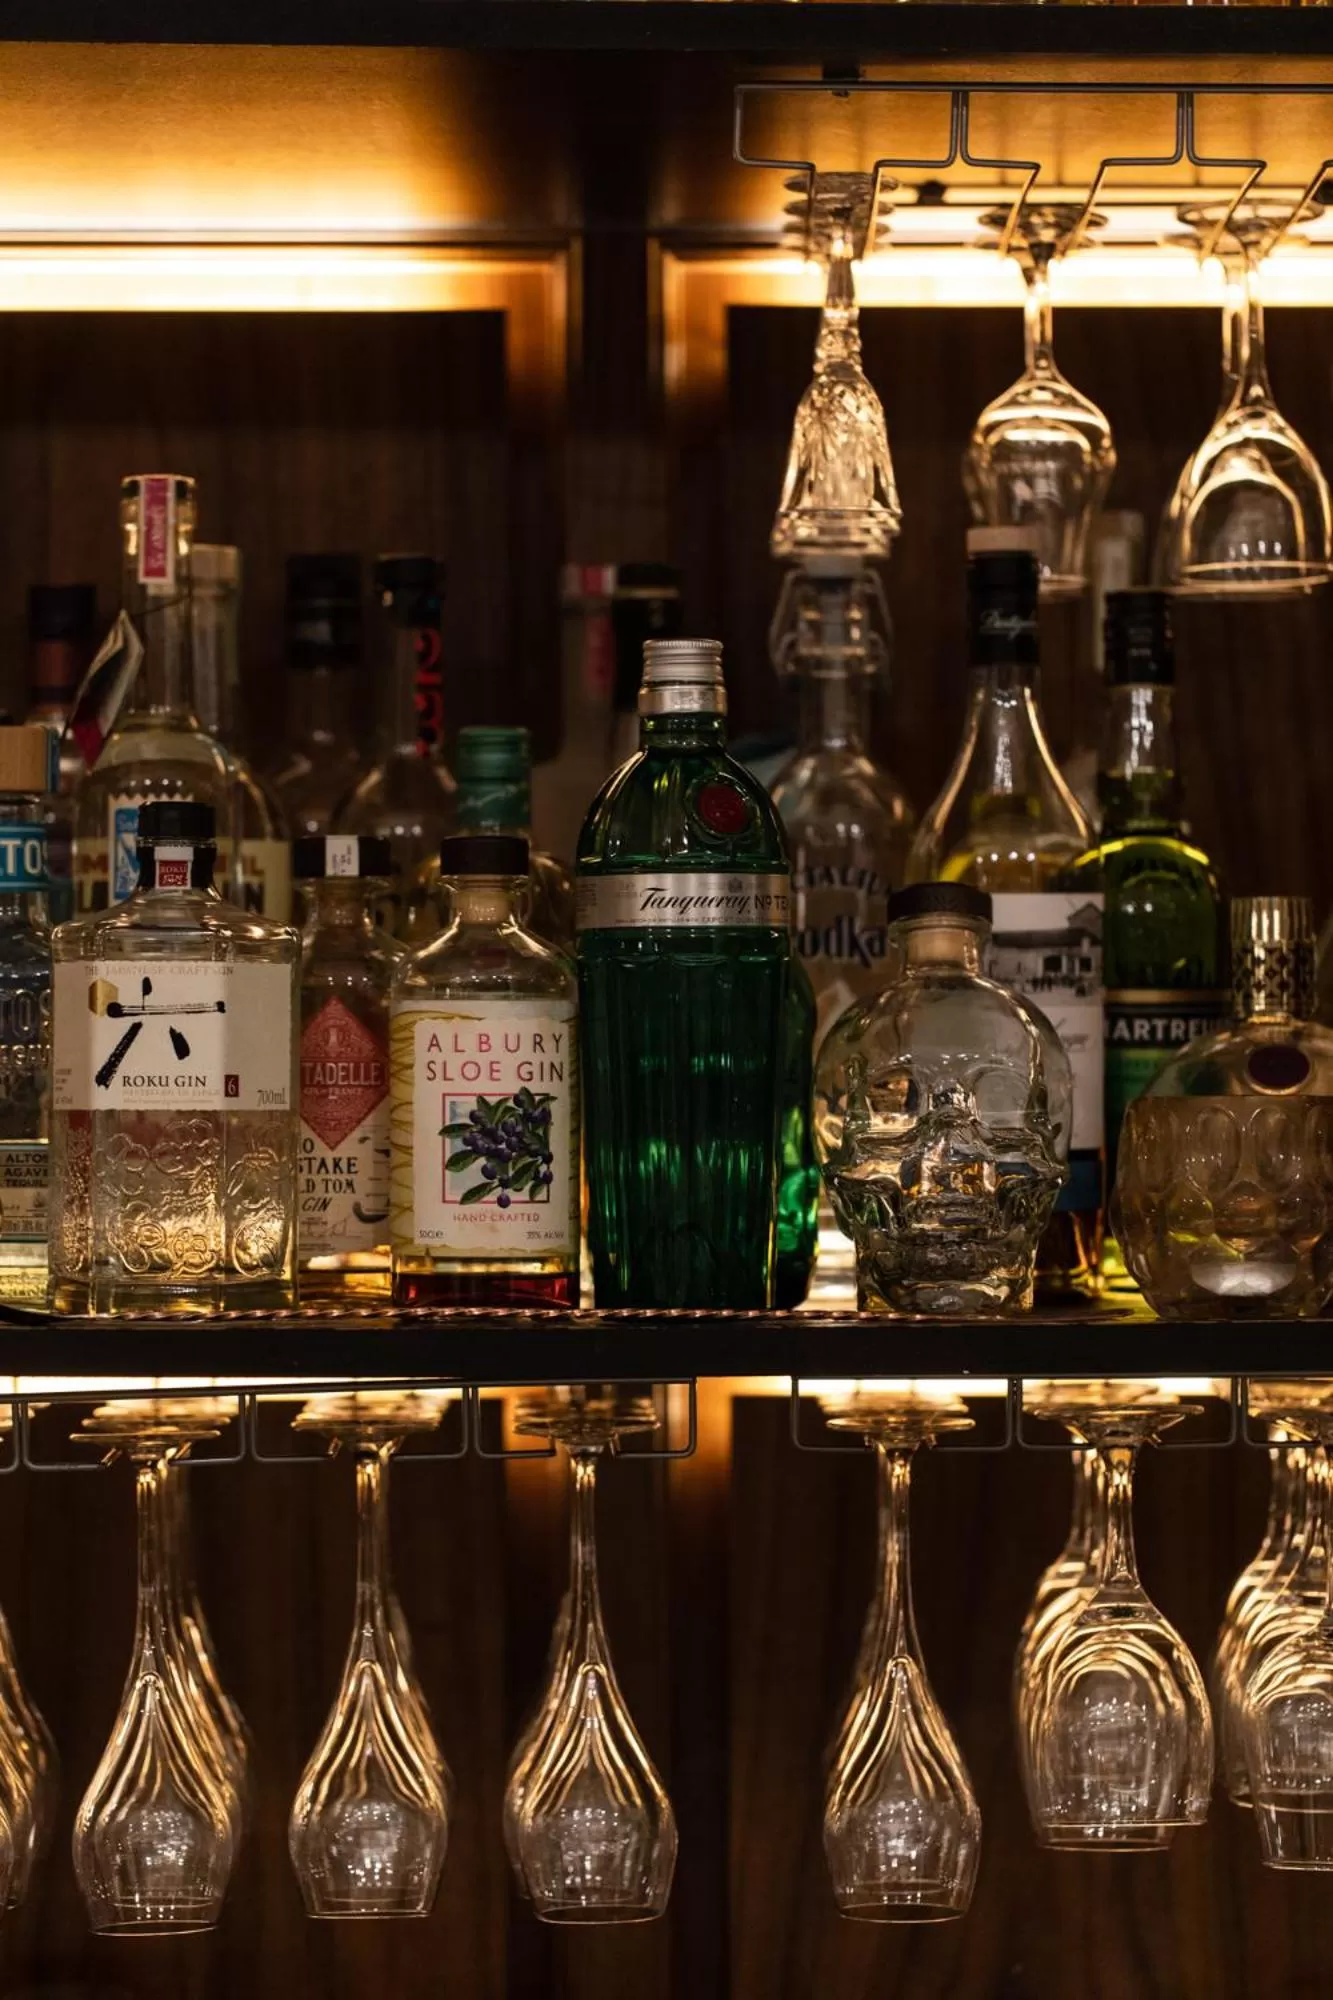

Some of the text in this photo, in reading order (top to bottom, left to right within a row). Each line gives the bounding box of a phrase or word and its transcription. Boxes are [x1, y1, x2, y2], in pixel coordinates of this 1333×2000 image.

[639, 887, 751, 915] Tanqueray
[797, 915, 888, 968] odka
[85, 965, 98, 976] THE
[94, 976, 226, 1090] 六
[427, 1033, 563, 1054] ALBURY
[426, 1060, 564, 1082] SLOE GIN
[122, 1075, 207, 1087] ROKU GIN
[300, 1137, 314, 1154] O
[5, 1179, 49, 1188] TEQUIL
[321, 1178, 356, 1194] TOM
[301, 1196, 333, 1212] GIN
[453, 1211, 541, 1222] HAND CRAFTED
